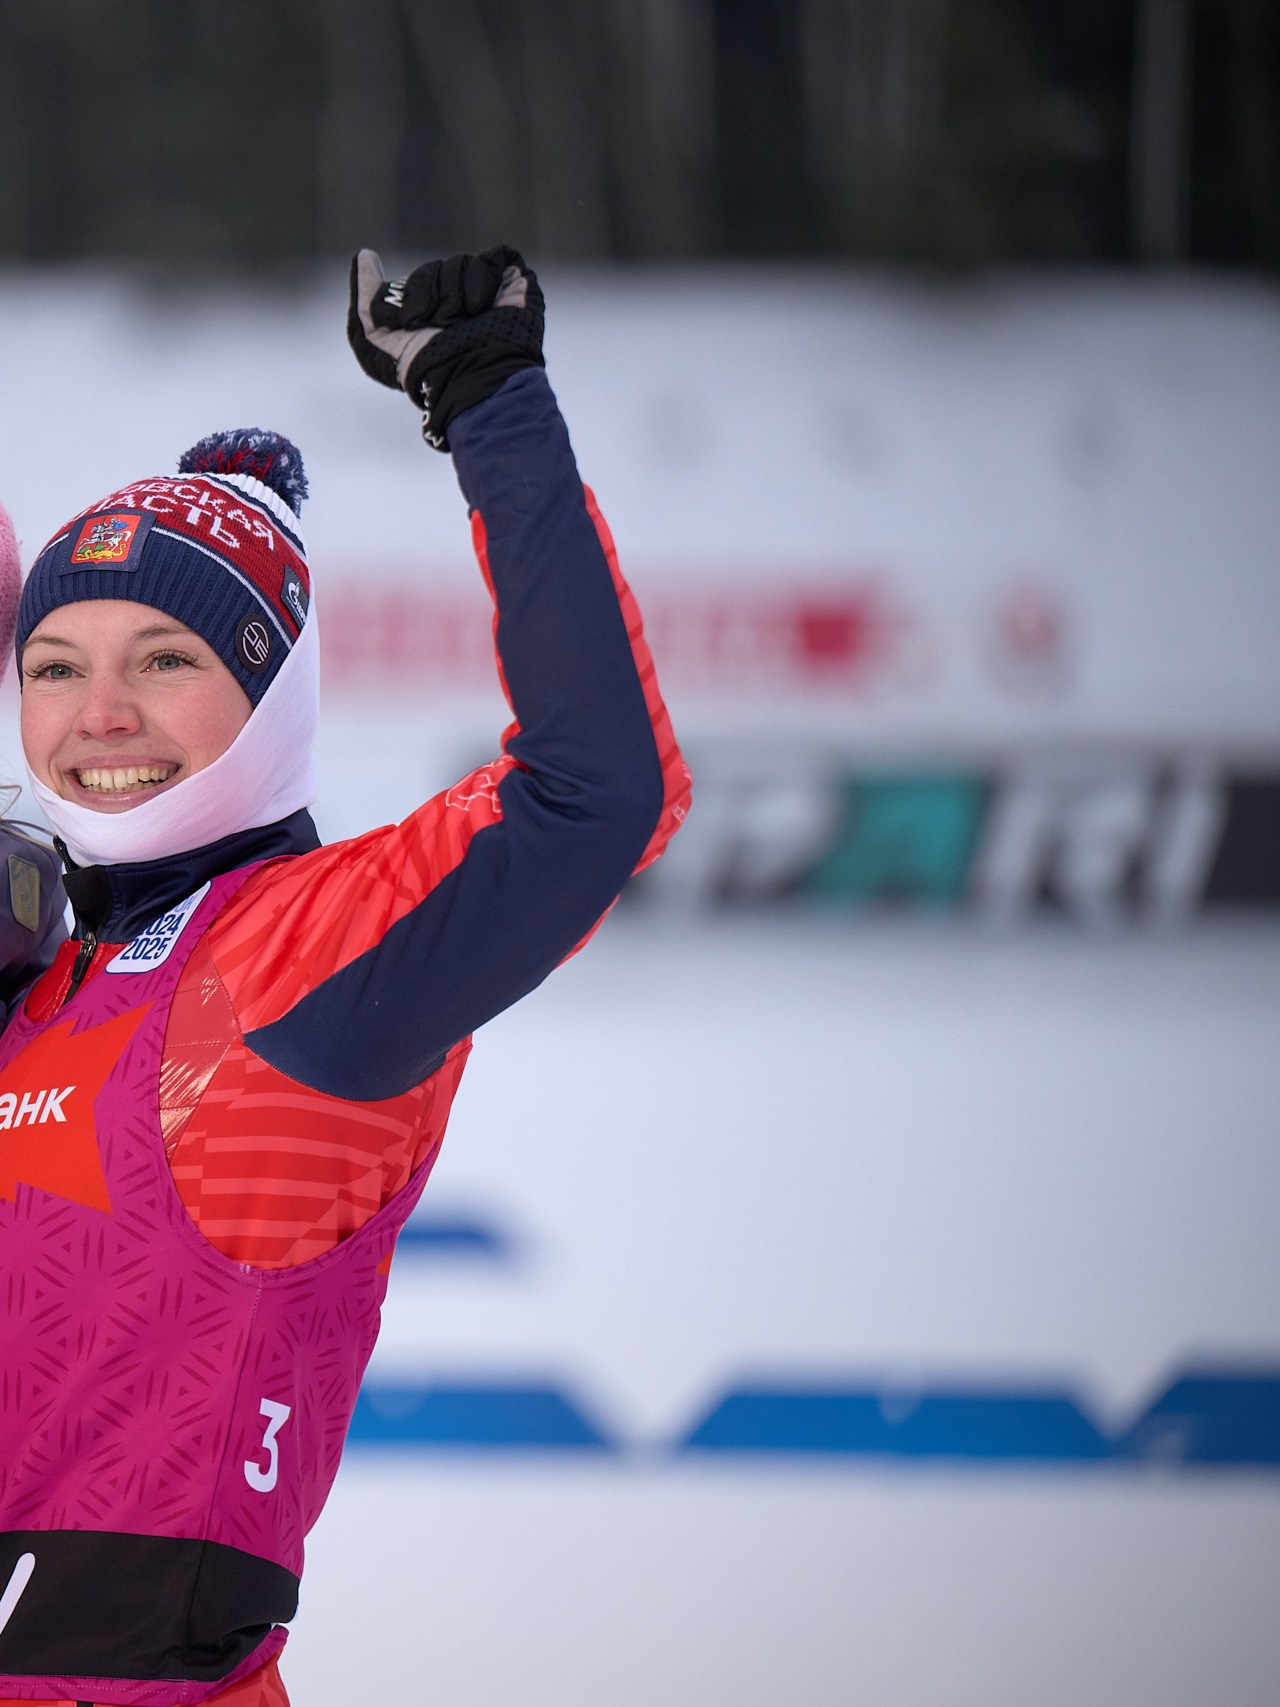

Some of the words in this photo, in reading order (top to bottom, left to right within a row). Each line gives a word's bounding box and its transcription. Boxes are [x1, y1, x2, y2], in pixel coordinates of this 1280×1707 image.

[141, 912, 186, 936] 024
[120, 937, 173, 960] 2025
[244, 1397, 292, 1493] 3
